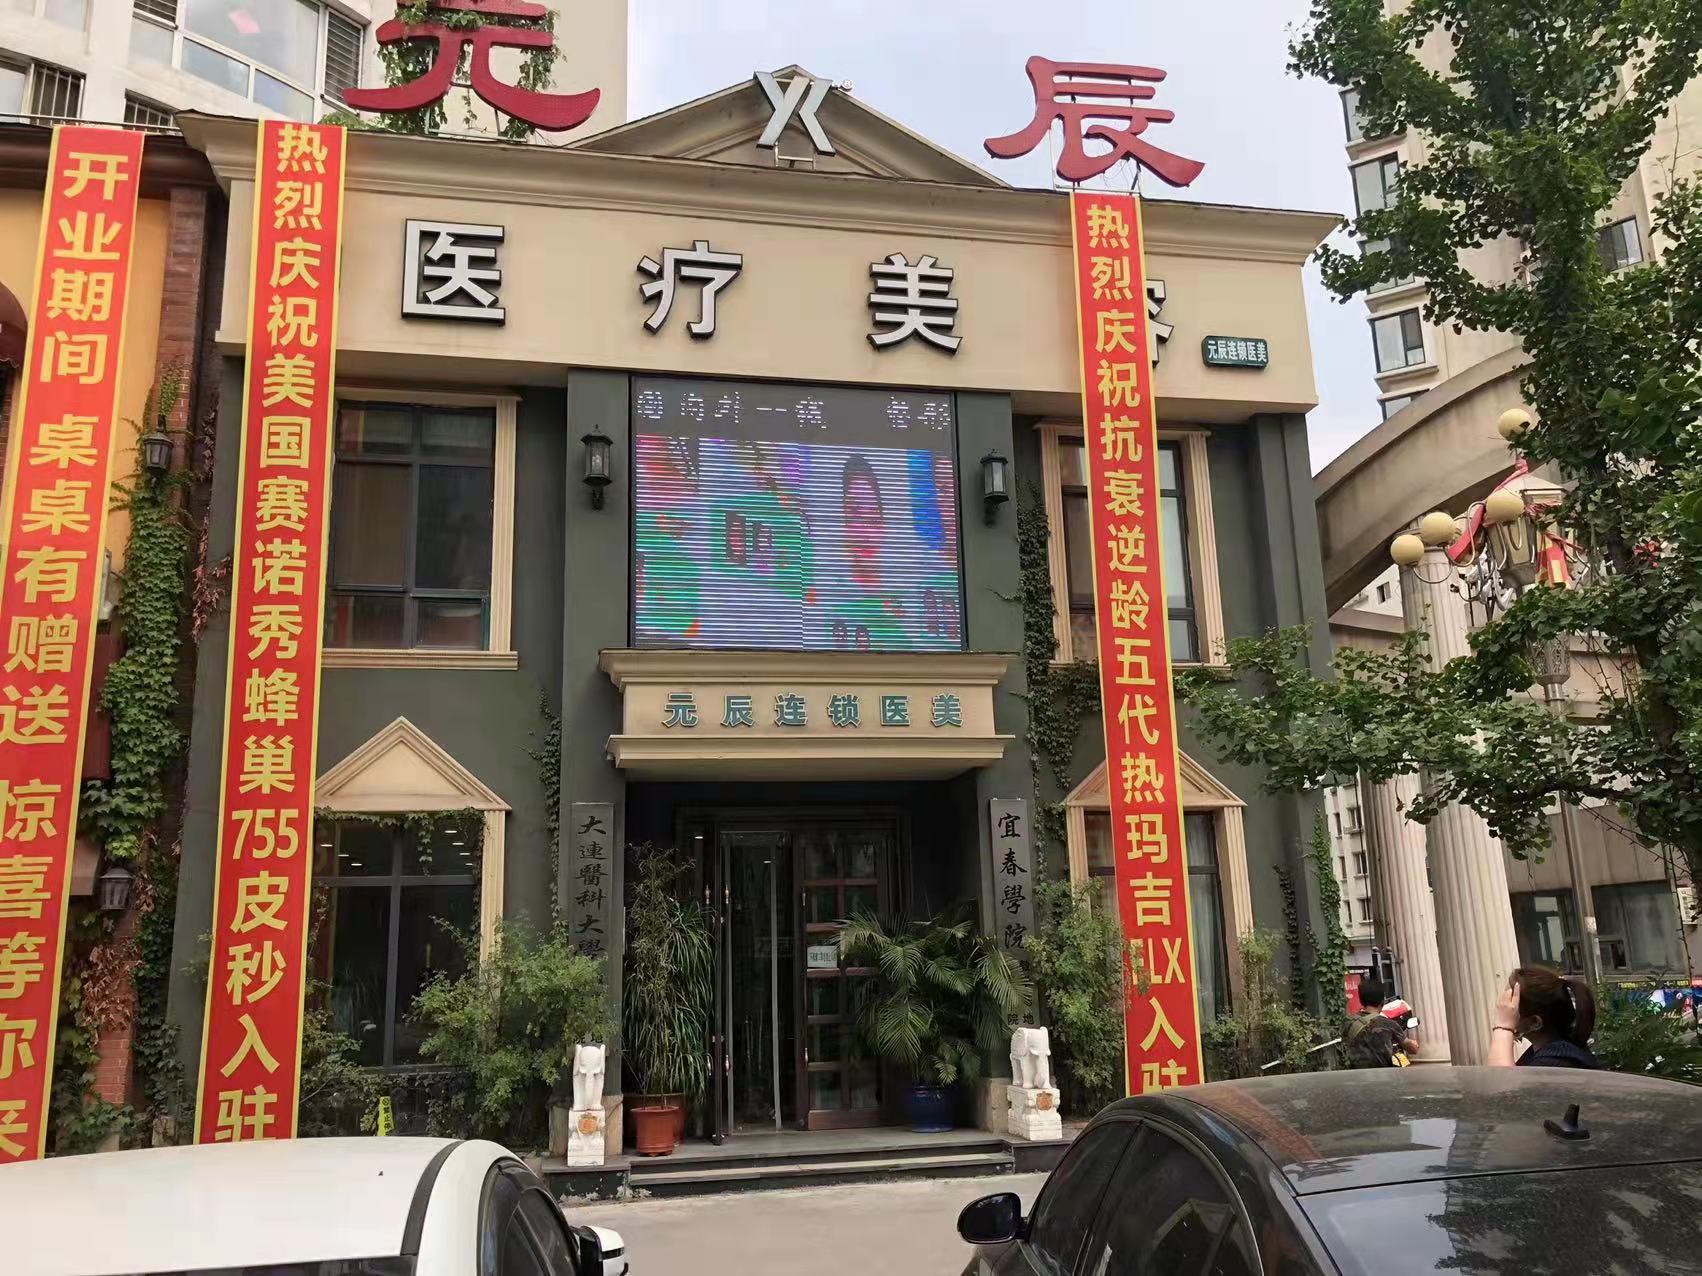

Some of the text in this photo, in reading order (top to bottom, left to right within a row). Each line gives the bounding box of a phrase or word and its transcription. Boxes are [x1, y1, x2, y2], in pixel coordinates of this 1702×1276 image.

[1207, 340, 1267, 362] 元辰连锁医美
[214, 124, 328, 1142] 热烈庆祝美国赛诺秀蜂巢755皮秒入驻
[662, 692, 964, 728] 元辰连锁医美
[997, 813, 1028, 949] 宜春學院
